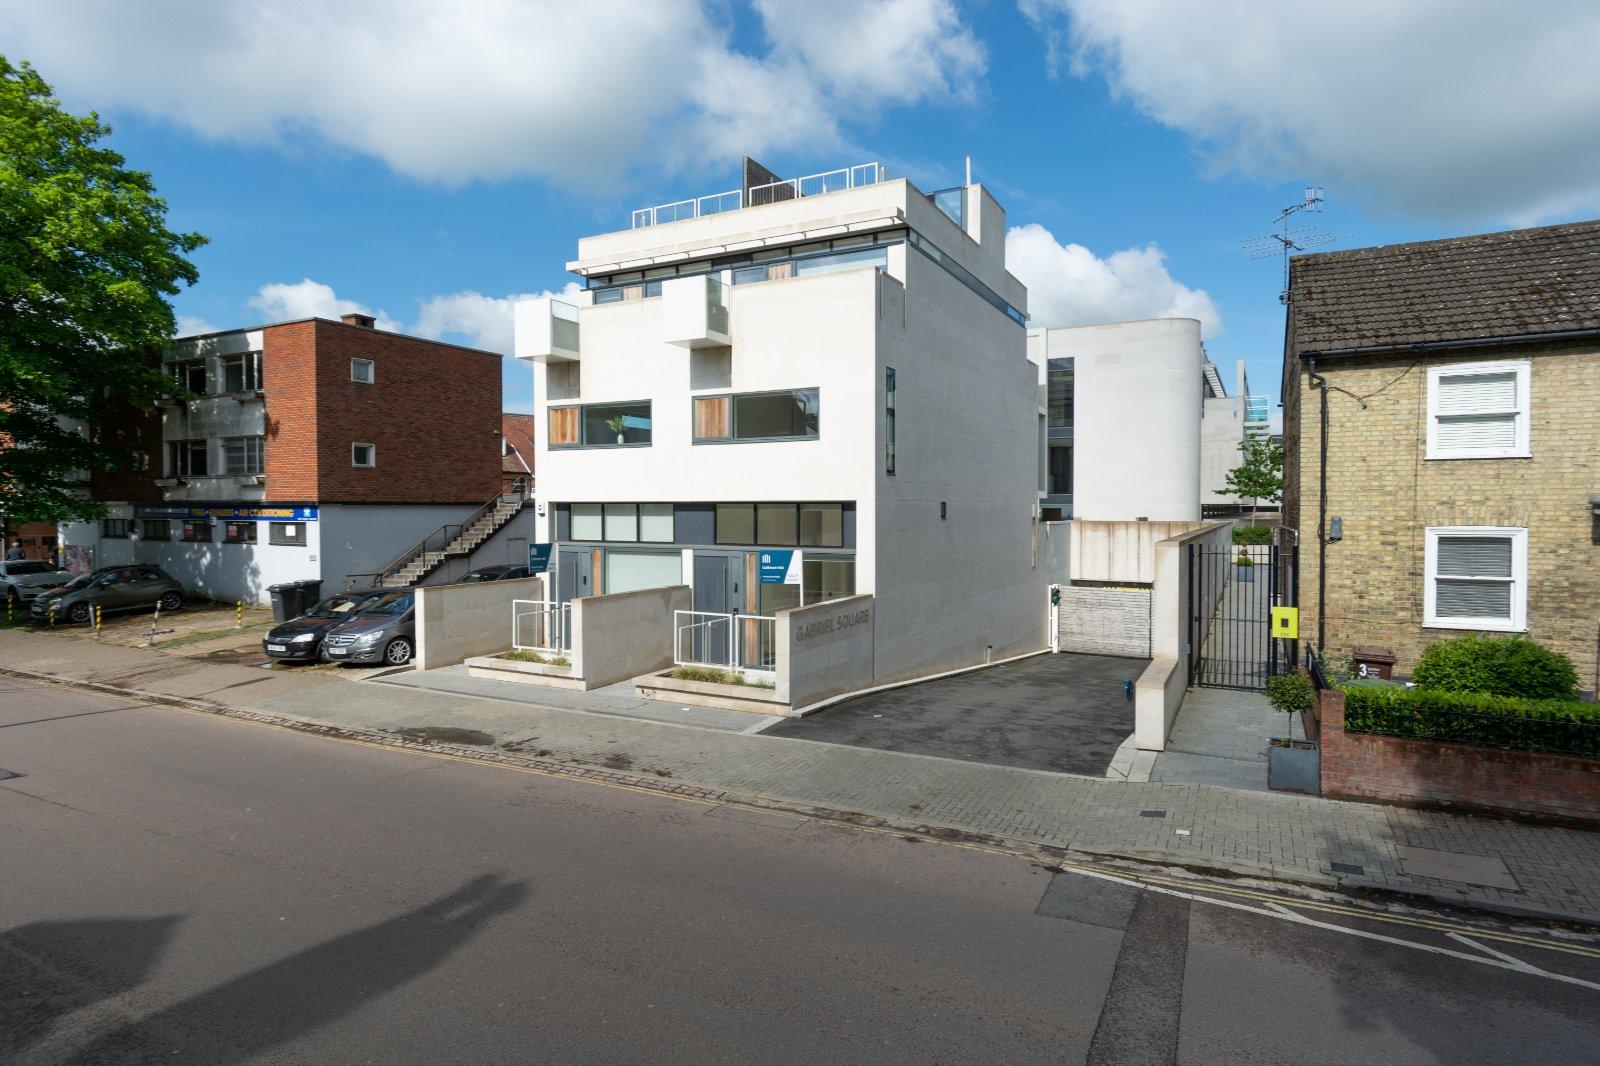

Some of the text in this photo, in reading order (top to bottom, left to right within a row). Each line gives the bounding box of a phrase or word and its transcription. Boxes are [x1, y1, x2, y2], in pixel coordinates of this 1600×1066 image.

[796, 608, 870, 641] GABRIEL SQUARE
[1359, 663, 1367, 676] 3
